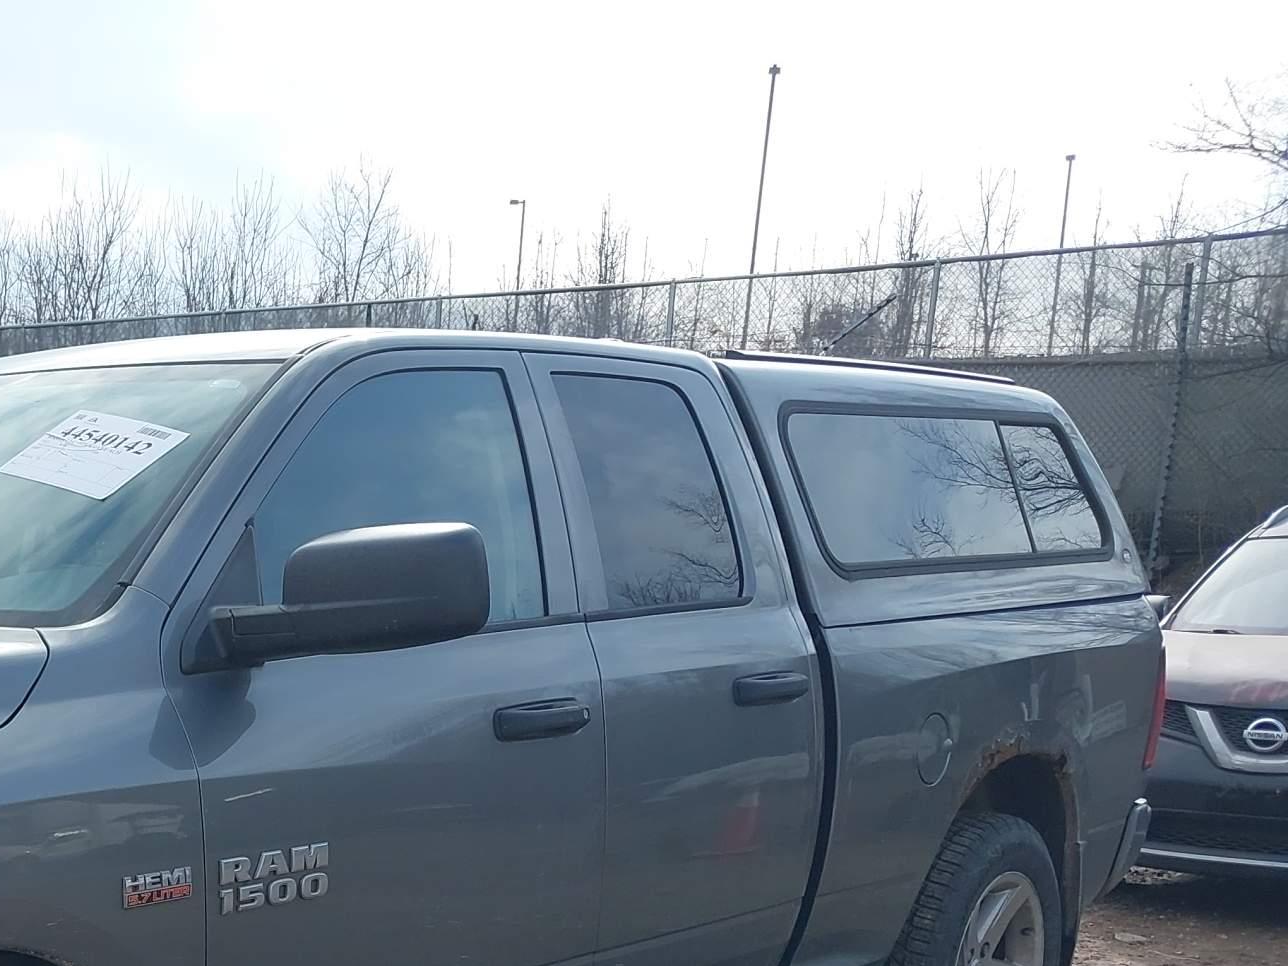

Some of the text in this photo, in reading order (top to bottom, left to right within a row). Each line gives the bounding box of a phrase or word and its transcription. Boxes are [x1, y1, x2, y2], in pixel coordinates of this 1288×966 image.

[61, 426, 153, 455] 44540142
[1247, 731, 1284, 740] NISSAN
[219, 841, 329, 885] RAM
[123, 866, 192, 893] HEMI
[152, 885, 190, 902] LITER
[219, 872, 329, 915] 1500
